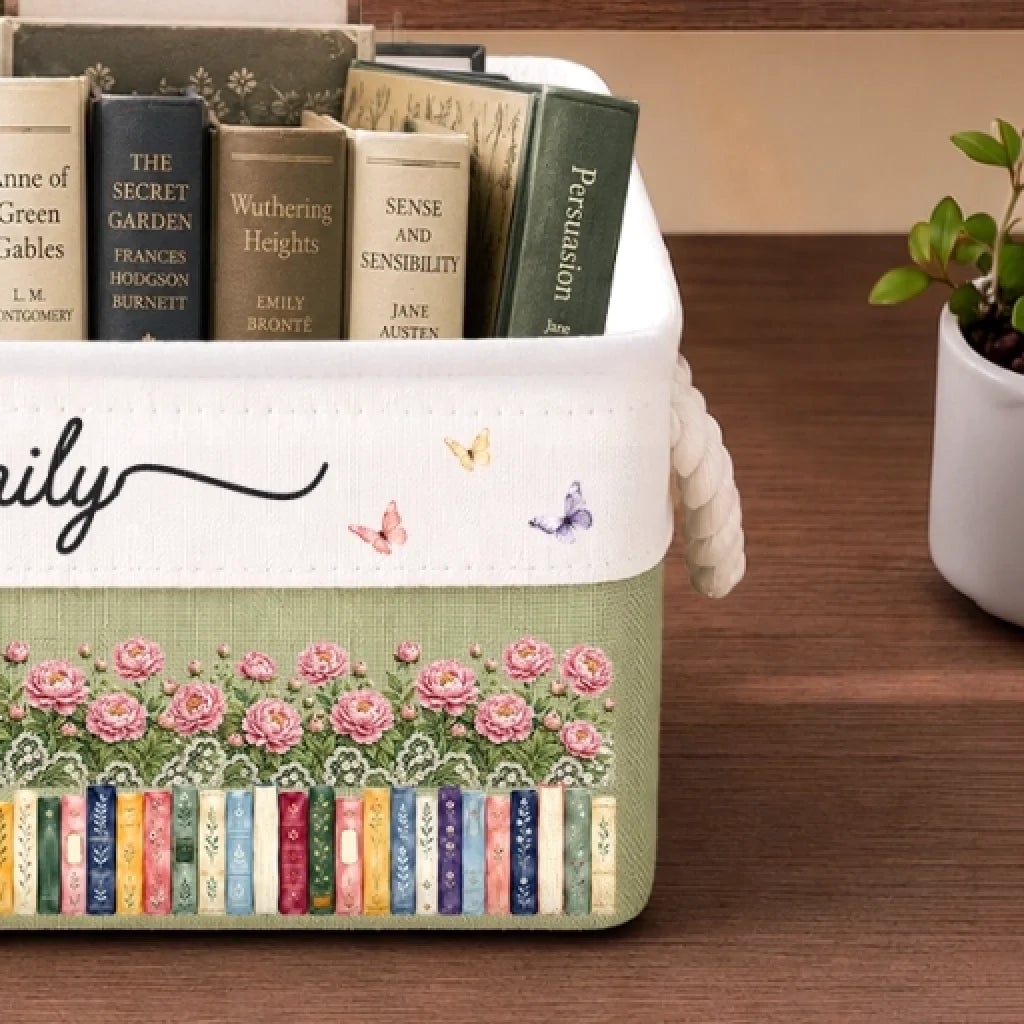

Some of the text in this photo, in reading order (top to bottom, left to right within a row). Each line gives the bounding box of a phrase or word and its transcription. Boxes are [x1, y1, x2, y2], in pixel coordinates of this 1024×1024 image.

[129, 153, 173, 172] THE
[49, 166, 71, 188] of
[112, 182, 191, 202] SECRET
[230, 193, 333, 225] Wuthering
[385, 197, 443, 217] SENSE
[107, 212, 192, 231] GARDEN
[395, 227, 432, 243] AND
[553, 164, 597, 302] Persuasion
[243, 230, 320, 258] Heights
[114, 247, 187, 265] FRANCES
[360, 251, 461, 273] SENSIBILITY
[110, 271, 190, 287] HODGSON
[13, 288, 26, 302] L.
[112, 294, 188, 311] BURNETT
[257, 295, 305, 311] EMILY
[389, 303, 430, 320] JANE
[379, 325, 439, 339] AUSTEN
